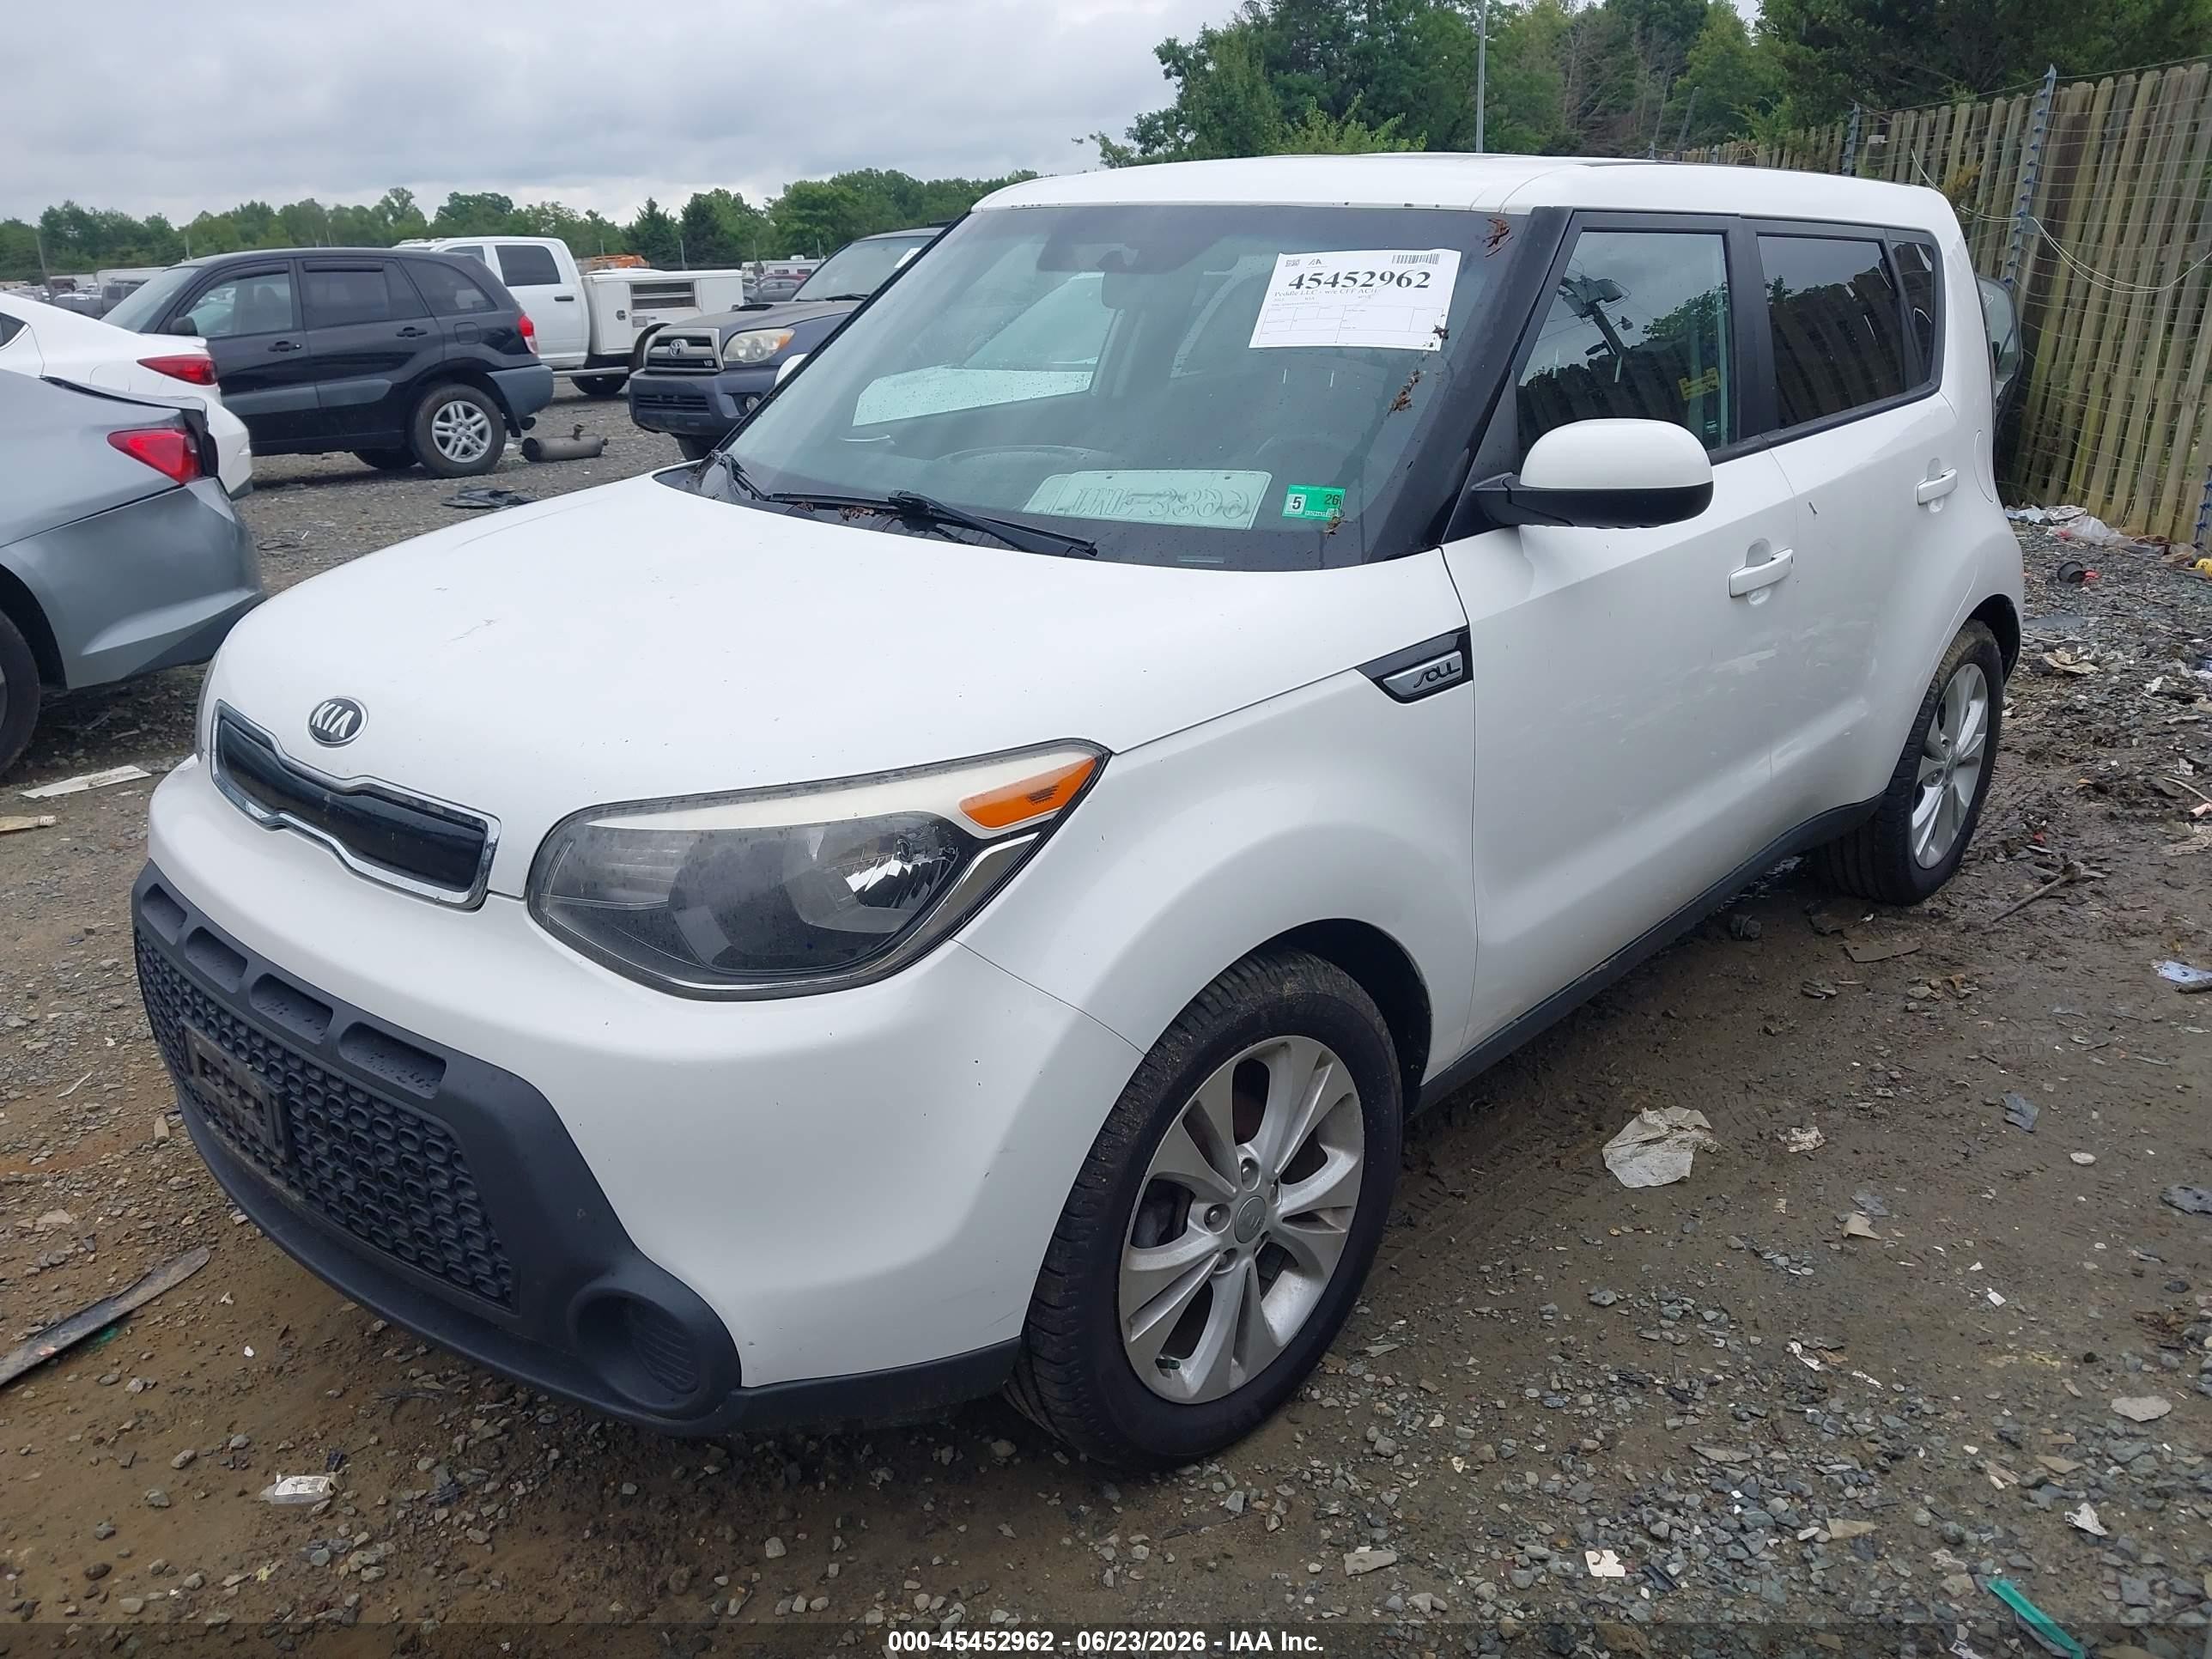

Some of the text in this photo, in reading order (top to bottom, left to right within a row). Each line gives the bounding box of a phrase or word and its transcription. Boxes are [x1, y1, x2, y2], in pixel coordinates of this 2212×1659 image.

[1288, 270, 1431, 289] 45452962
[1291, 494, 1340, 510] 5 26
[1413, 662, 1461, 688] SOUL
[311, 702, 355, 738] KIA
